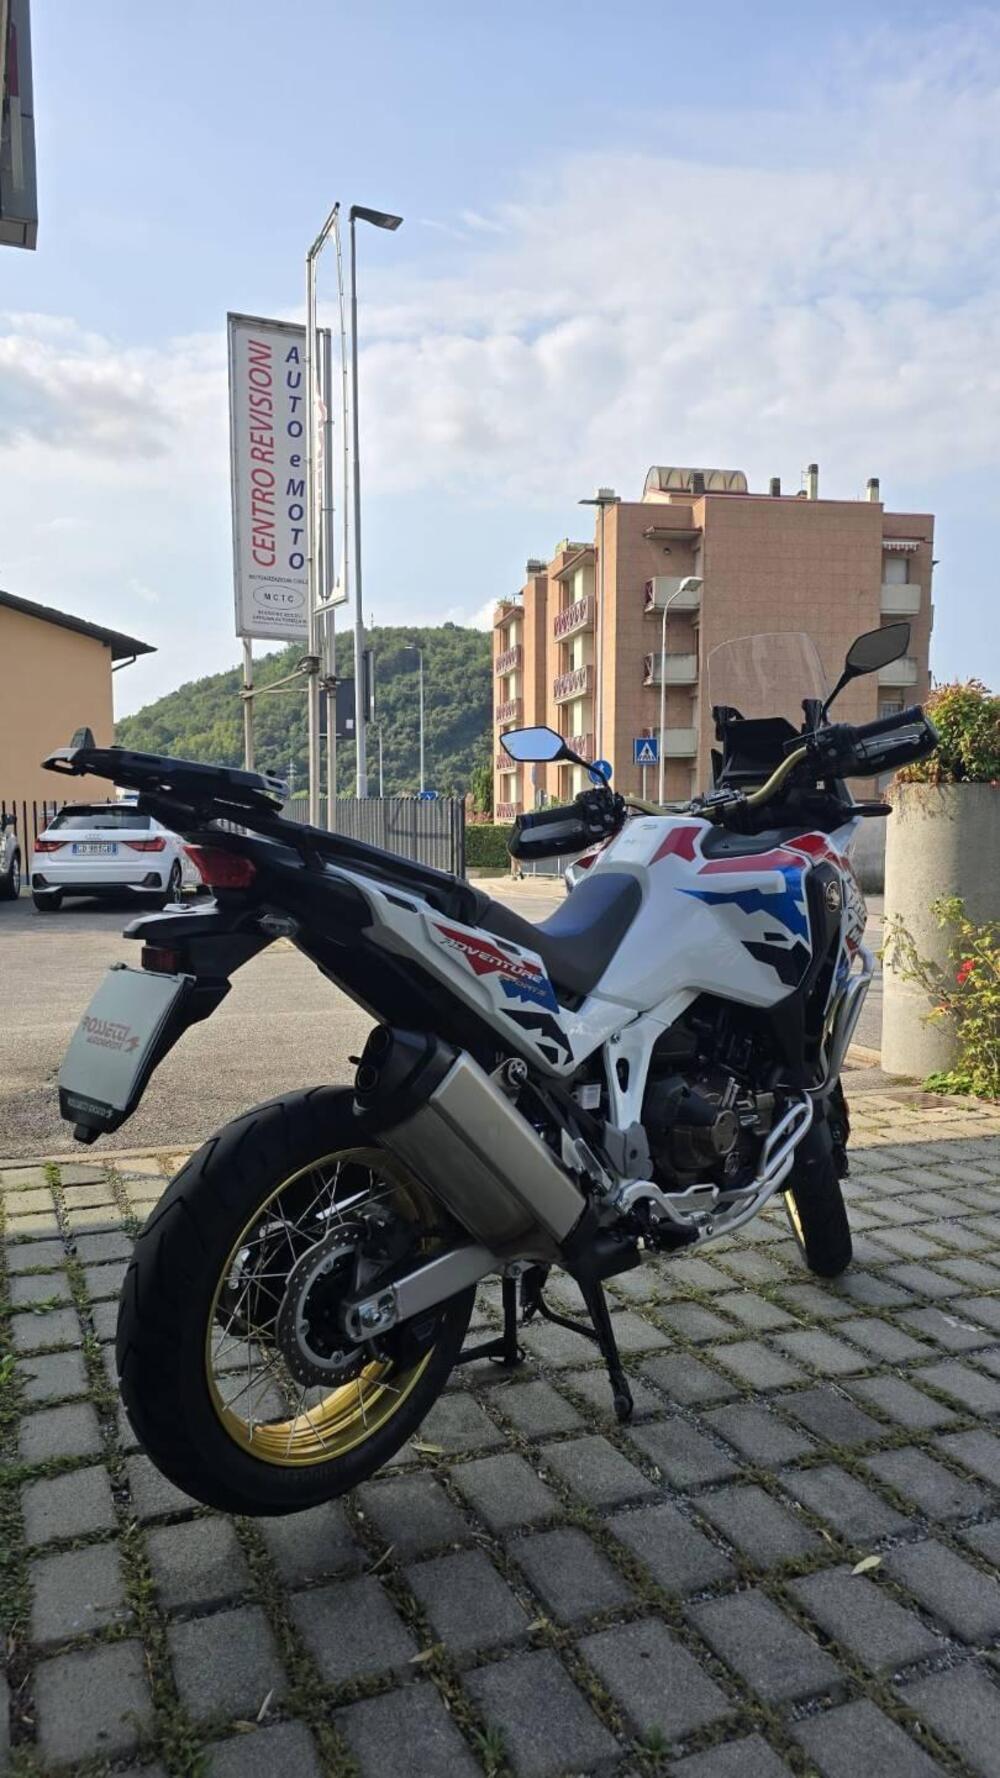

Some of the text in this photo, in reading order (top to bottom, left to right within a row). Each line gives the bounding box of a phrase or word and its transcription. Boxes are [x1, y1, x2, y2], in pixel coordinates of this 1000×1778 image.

[248, 339, 276, 567] CENTRO REVISIONI
[285, 346, 305, 570] AUTO e MOTO
[440, 937, 543, 983] ADVENTURE
